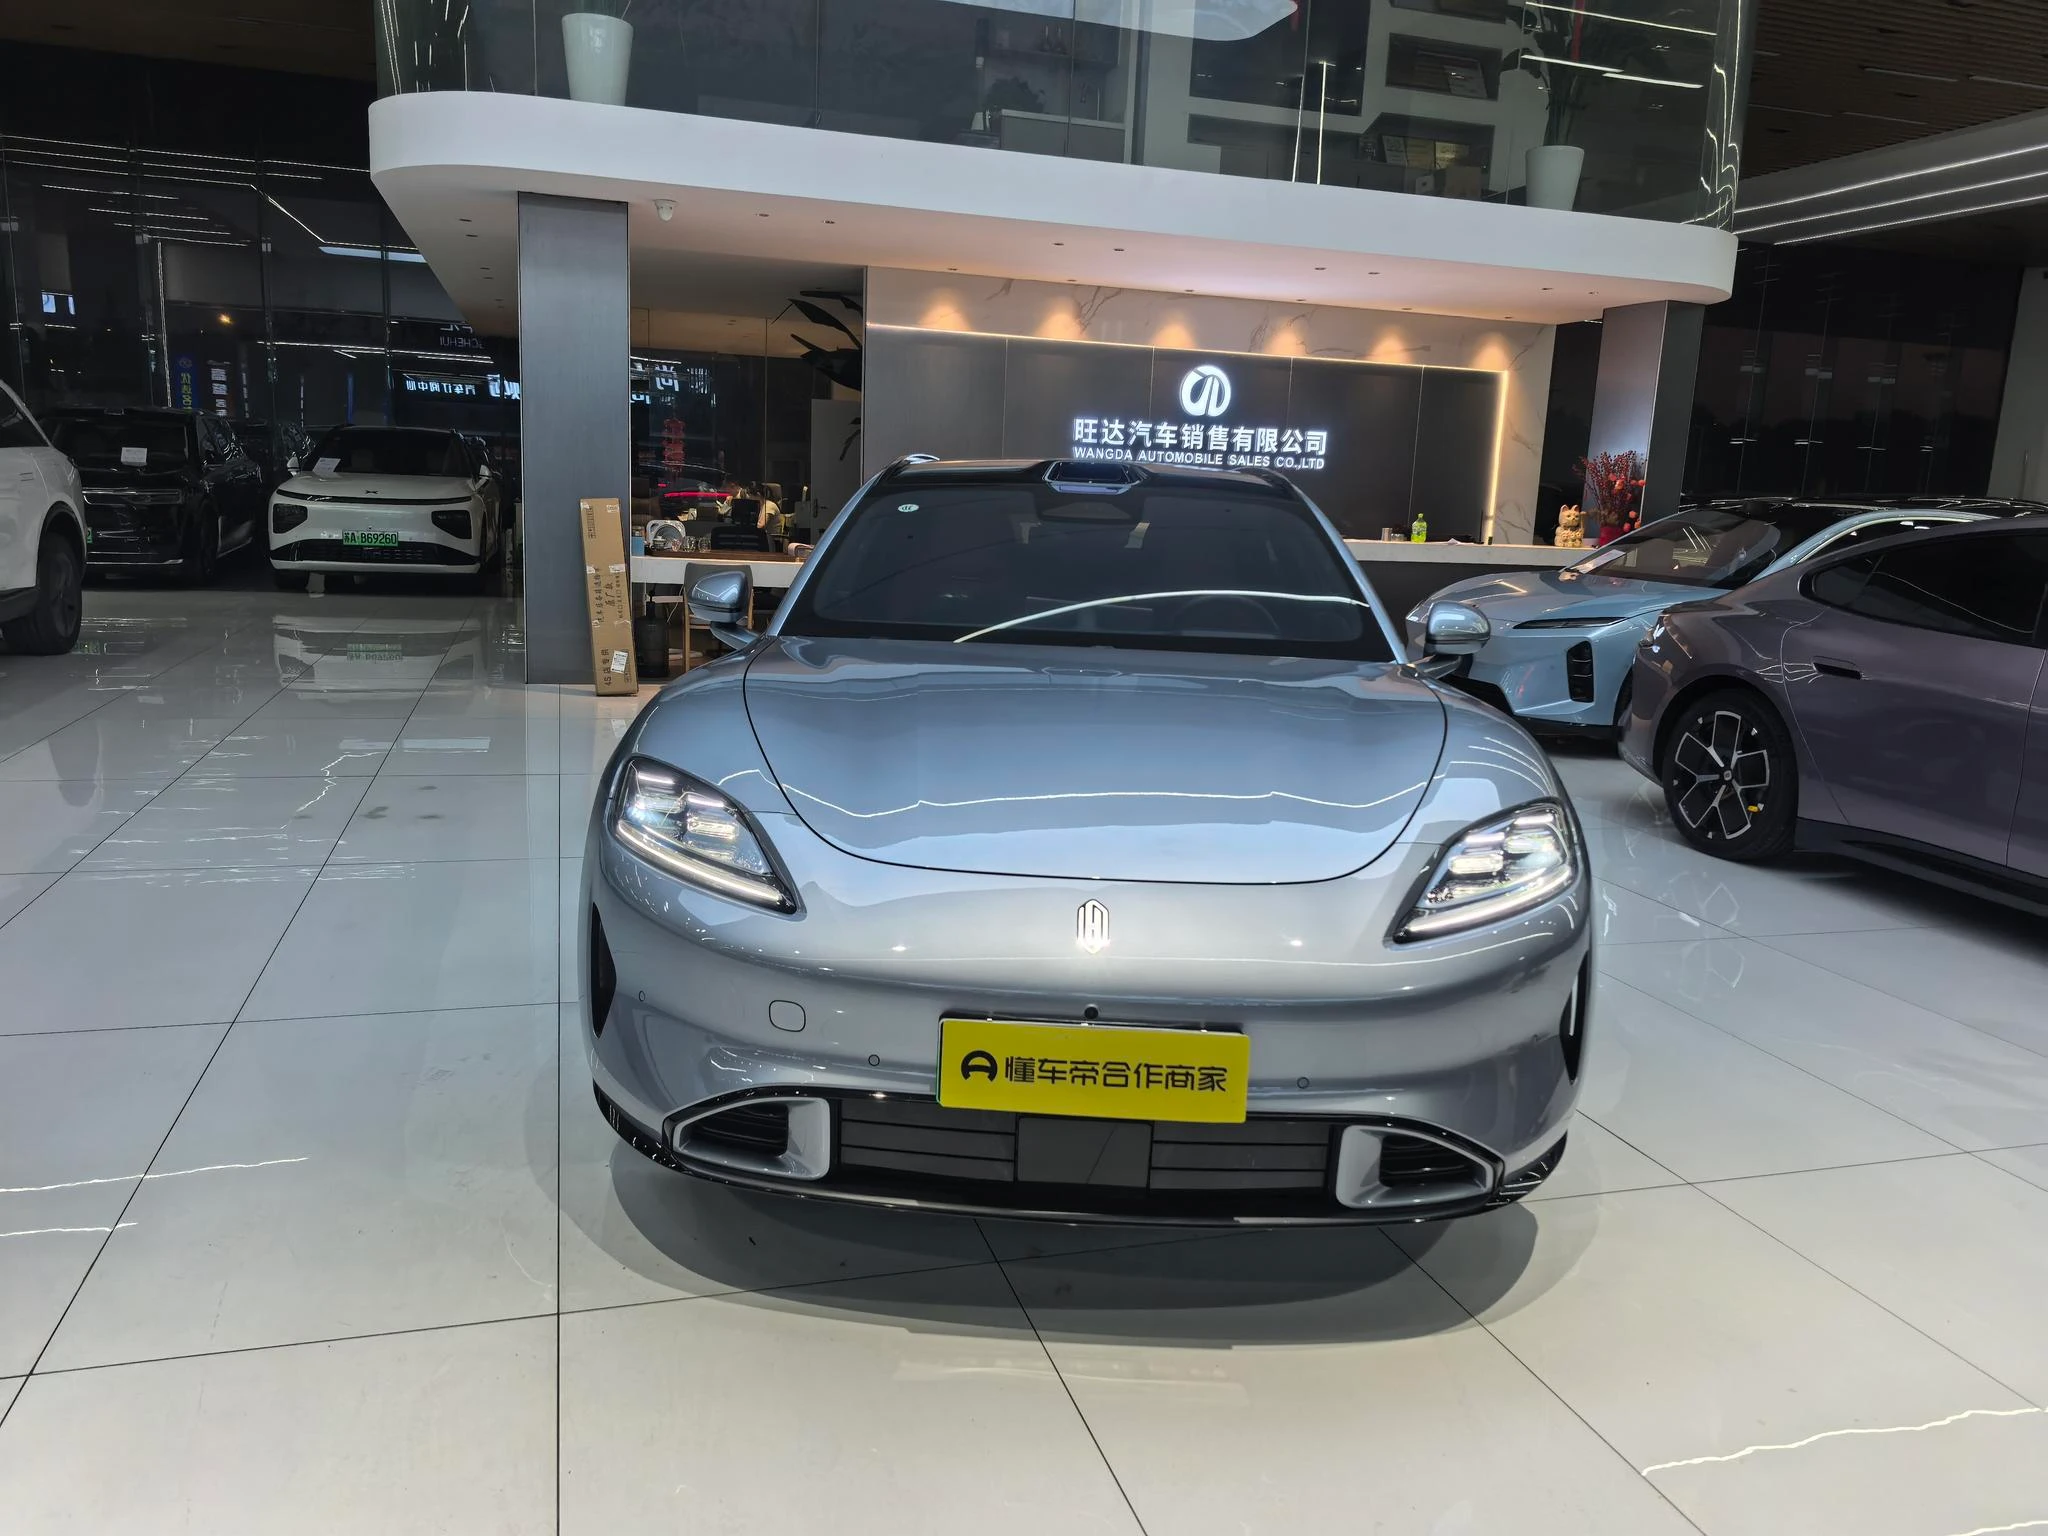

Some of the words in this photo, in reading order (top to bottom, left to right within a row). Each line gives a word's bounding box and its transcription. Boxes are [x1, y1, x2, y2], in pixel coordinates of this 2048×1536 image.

[1072, 418, 1328, 456] 旺达汽车销售有限公司
[1073, 446, 1134, 460] WANGDA
[1137, 449, 1224, 466] AUTOMOBILE
[1227, 454, 1271, 468] SALES
[1275, 456, 1326, 471] CO.,LTD
[360, 533, 397, 545] B69260
[1004, 1055, 1228, 1093] 懂车帝合作商家
